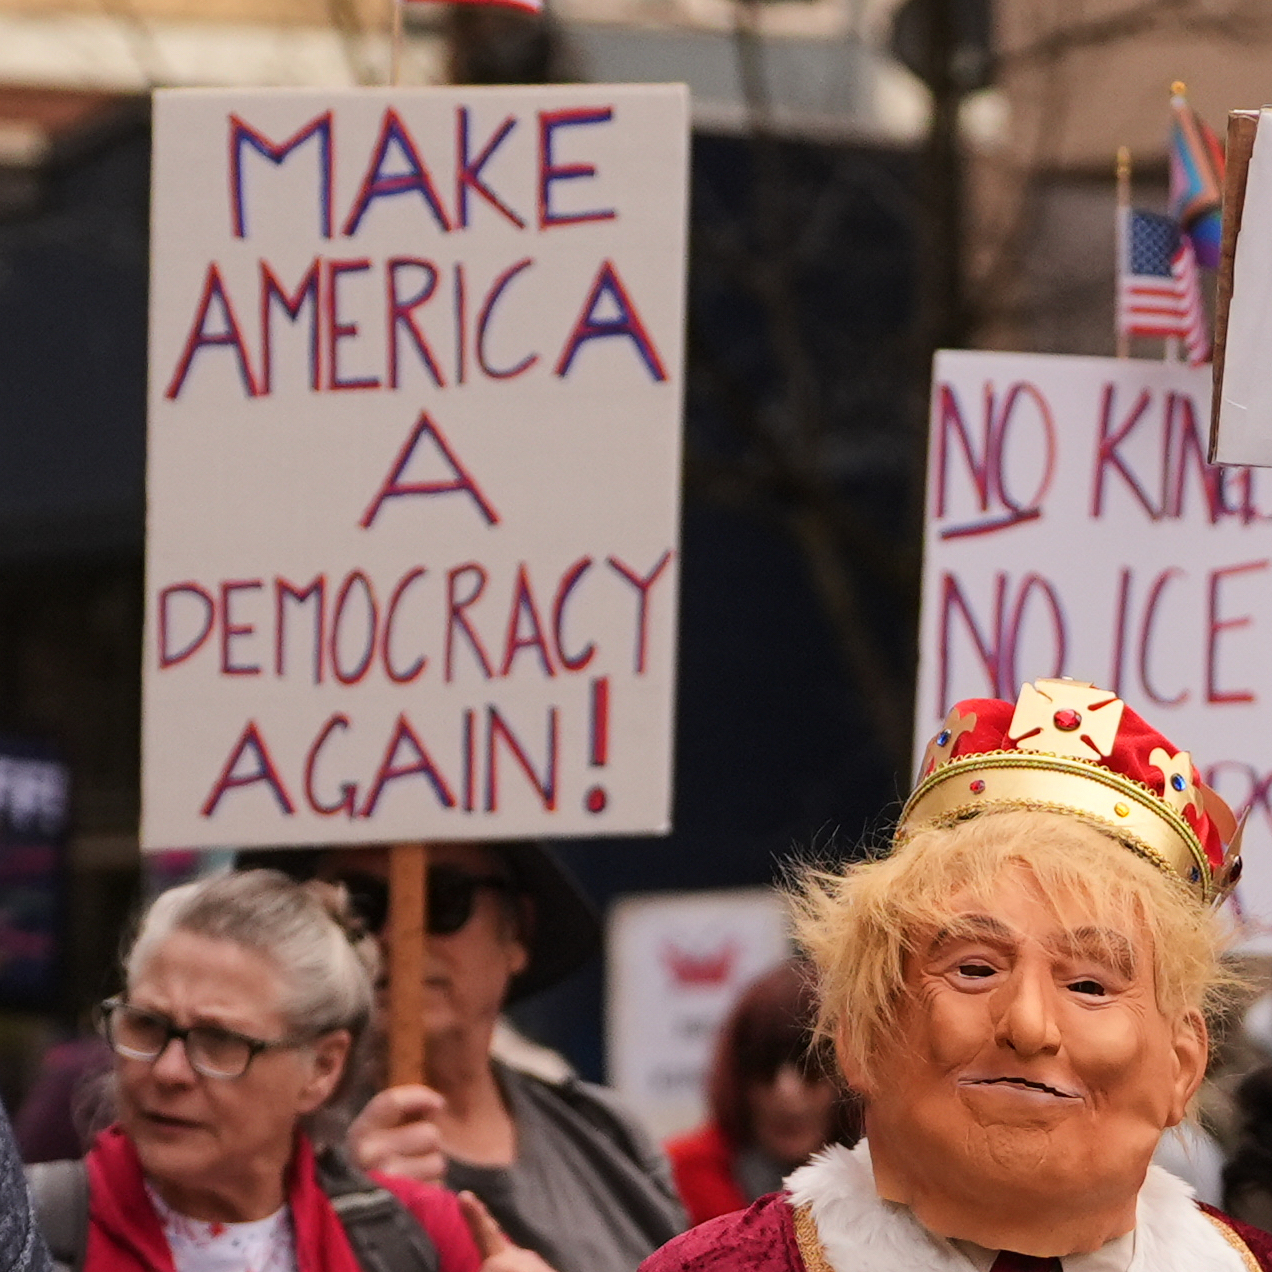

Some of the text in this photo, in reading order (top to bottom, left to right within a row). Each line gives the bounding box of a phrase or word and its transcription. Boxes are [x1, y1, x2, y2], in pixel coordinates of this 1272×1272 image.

[227, 104, 617, 239] MAKE
[164, 255, 670, 399] AMERICA
[358, 406, 502, 529] A
[934, 379, 1058, 520] NO
[156, 549, 676, 684] DEMOCRACY
[937, 568, 1069, 722] NO
[200, 675, 609, 819] AGAIN!
